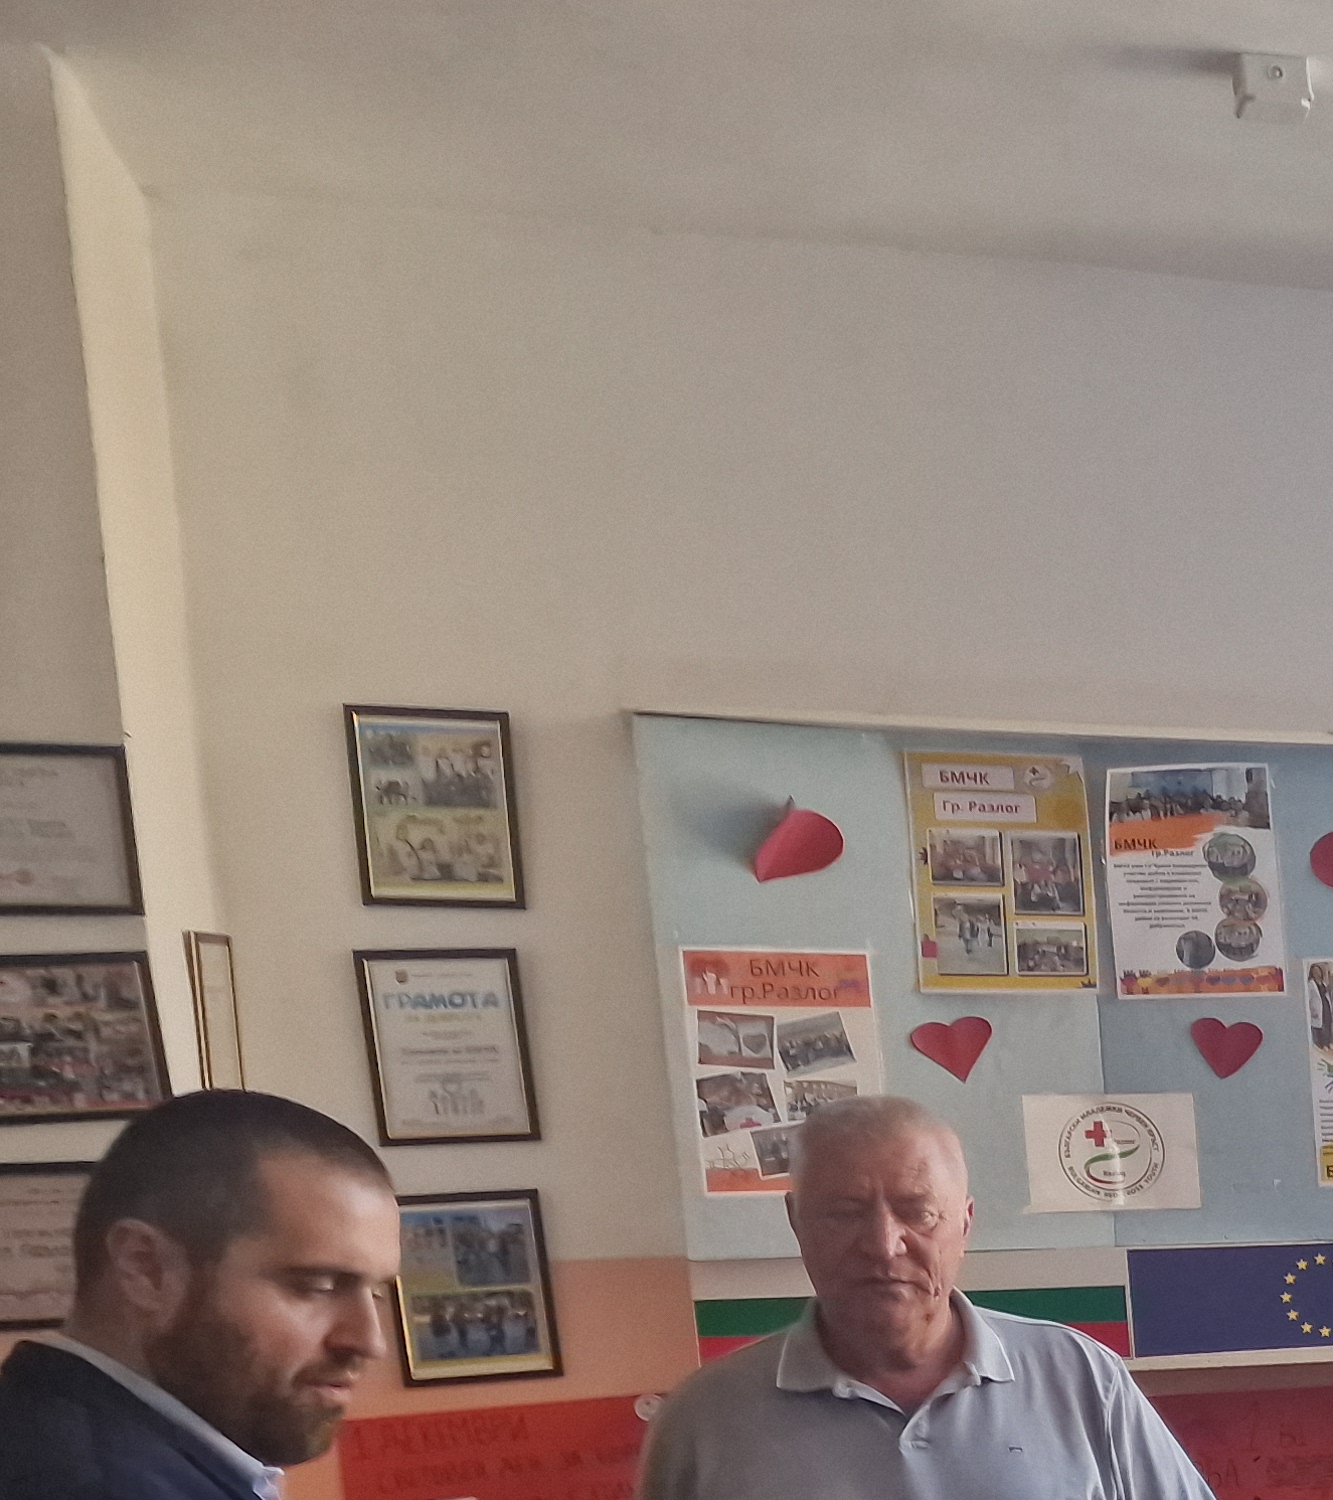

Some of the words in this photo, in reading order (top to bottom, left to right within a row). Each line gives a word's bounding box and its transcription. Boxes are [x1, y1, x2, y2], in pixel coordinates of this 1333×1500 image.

[939, 769, 990, 786] БМЧК
[942, 800, 963, 815] Гр.
[968, 800, 1021, 814] Разлог
[1114, 837, 1158, 850] БМЧК
[749, 959, 820, 978] БМЧК
[381, 992, 500, 1010] ГРАМОТА
[730, 982, 839, 1005] гр.Разлог
